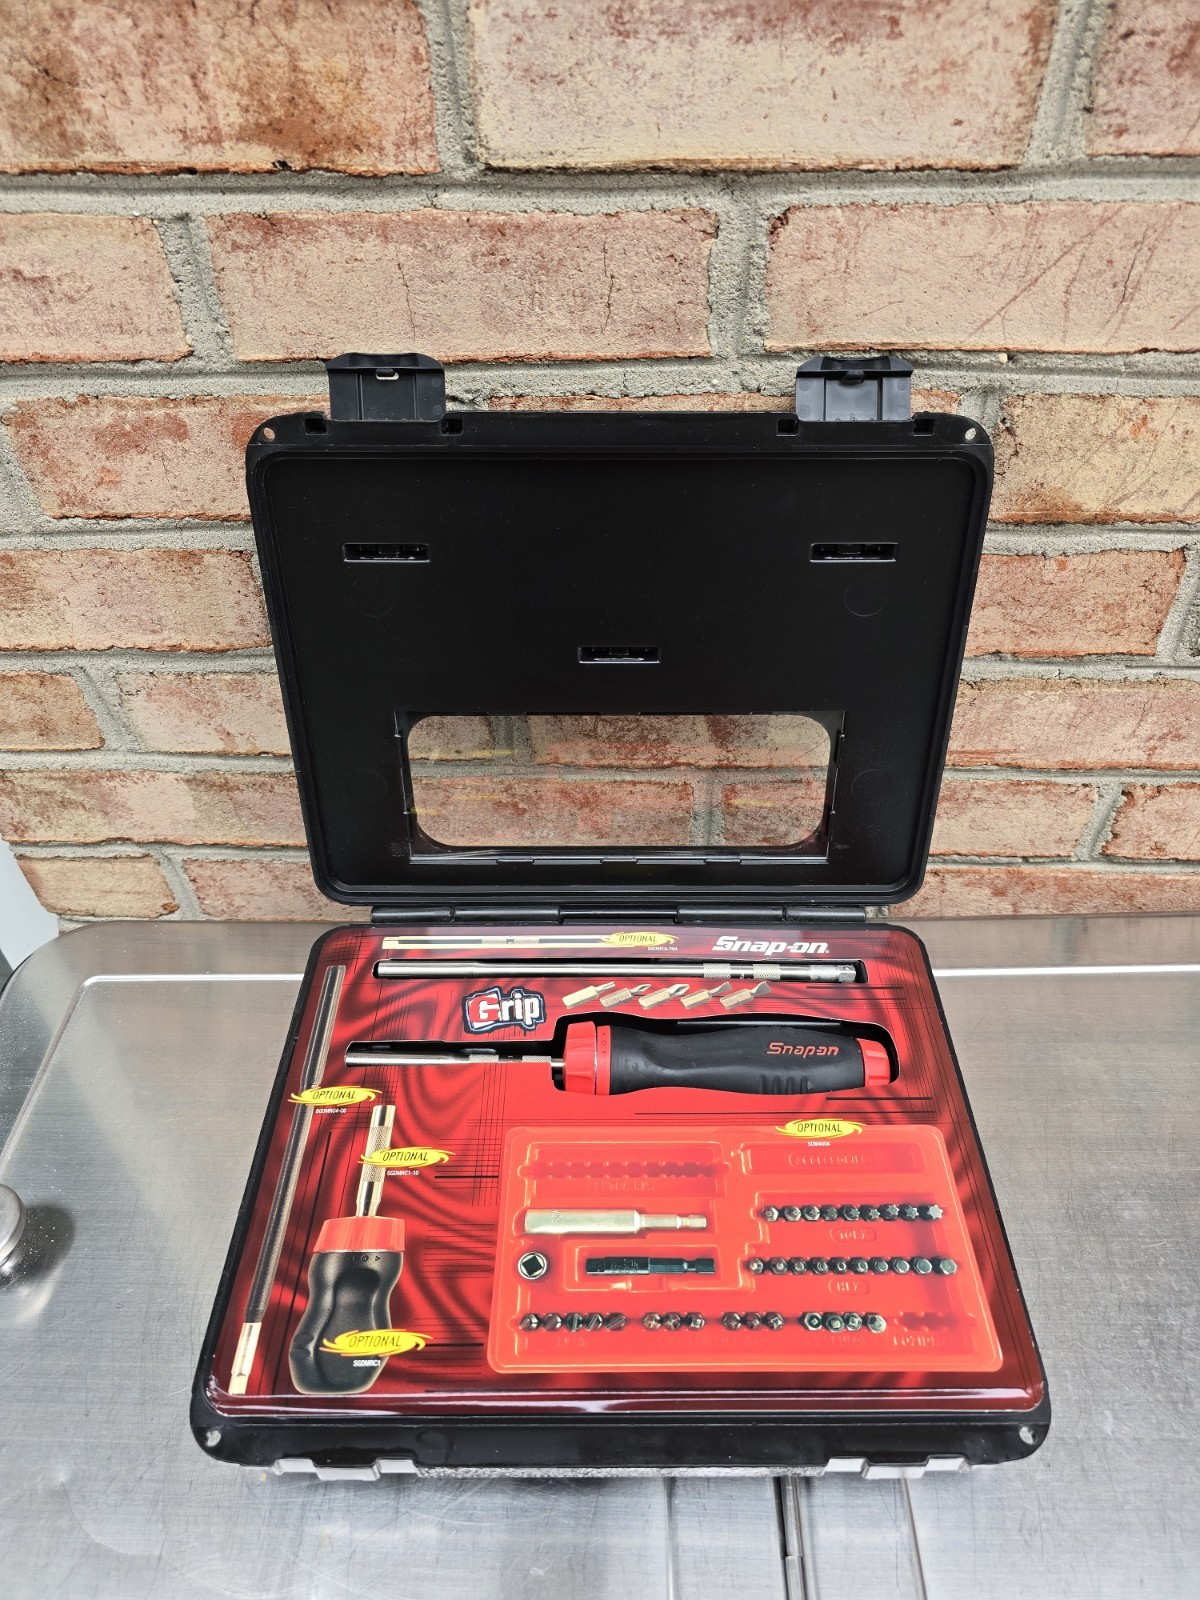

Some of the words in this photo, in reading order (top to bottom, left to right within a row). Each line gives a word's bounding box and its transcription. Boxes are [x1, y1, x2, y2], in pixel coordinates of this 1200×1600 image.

[618, 934, 657, 943] OPTIONAL
[467, 991, 540, 1026] Grip
[311, 1090, 357, 1100] OPTIONAL
[797, 1123, 843, 1133] OPTIONAL
[381, 1151, 429, 1162] OPTIONAL
[348, 1335, 402, 1348] OPTIONAL
